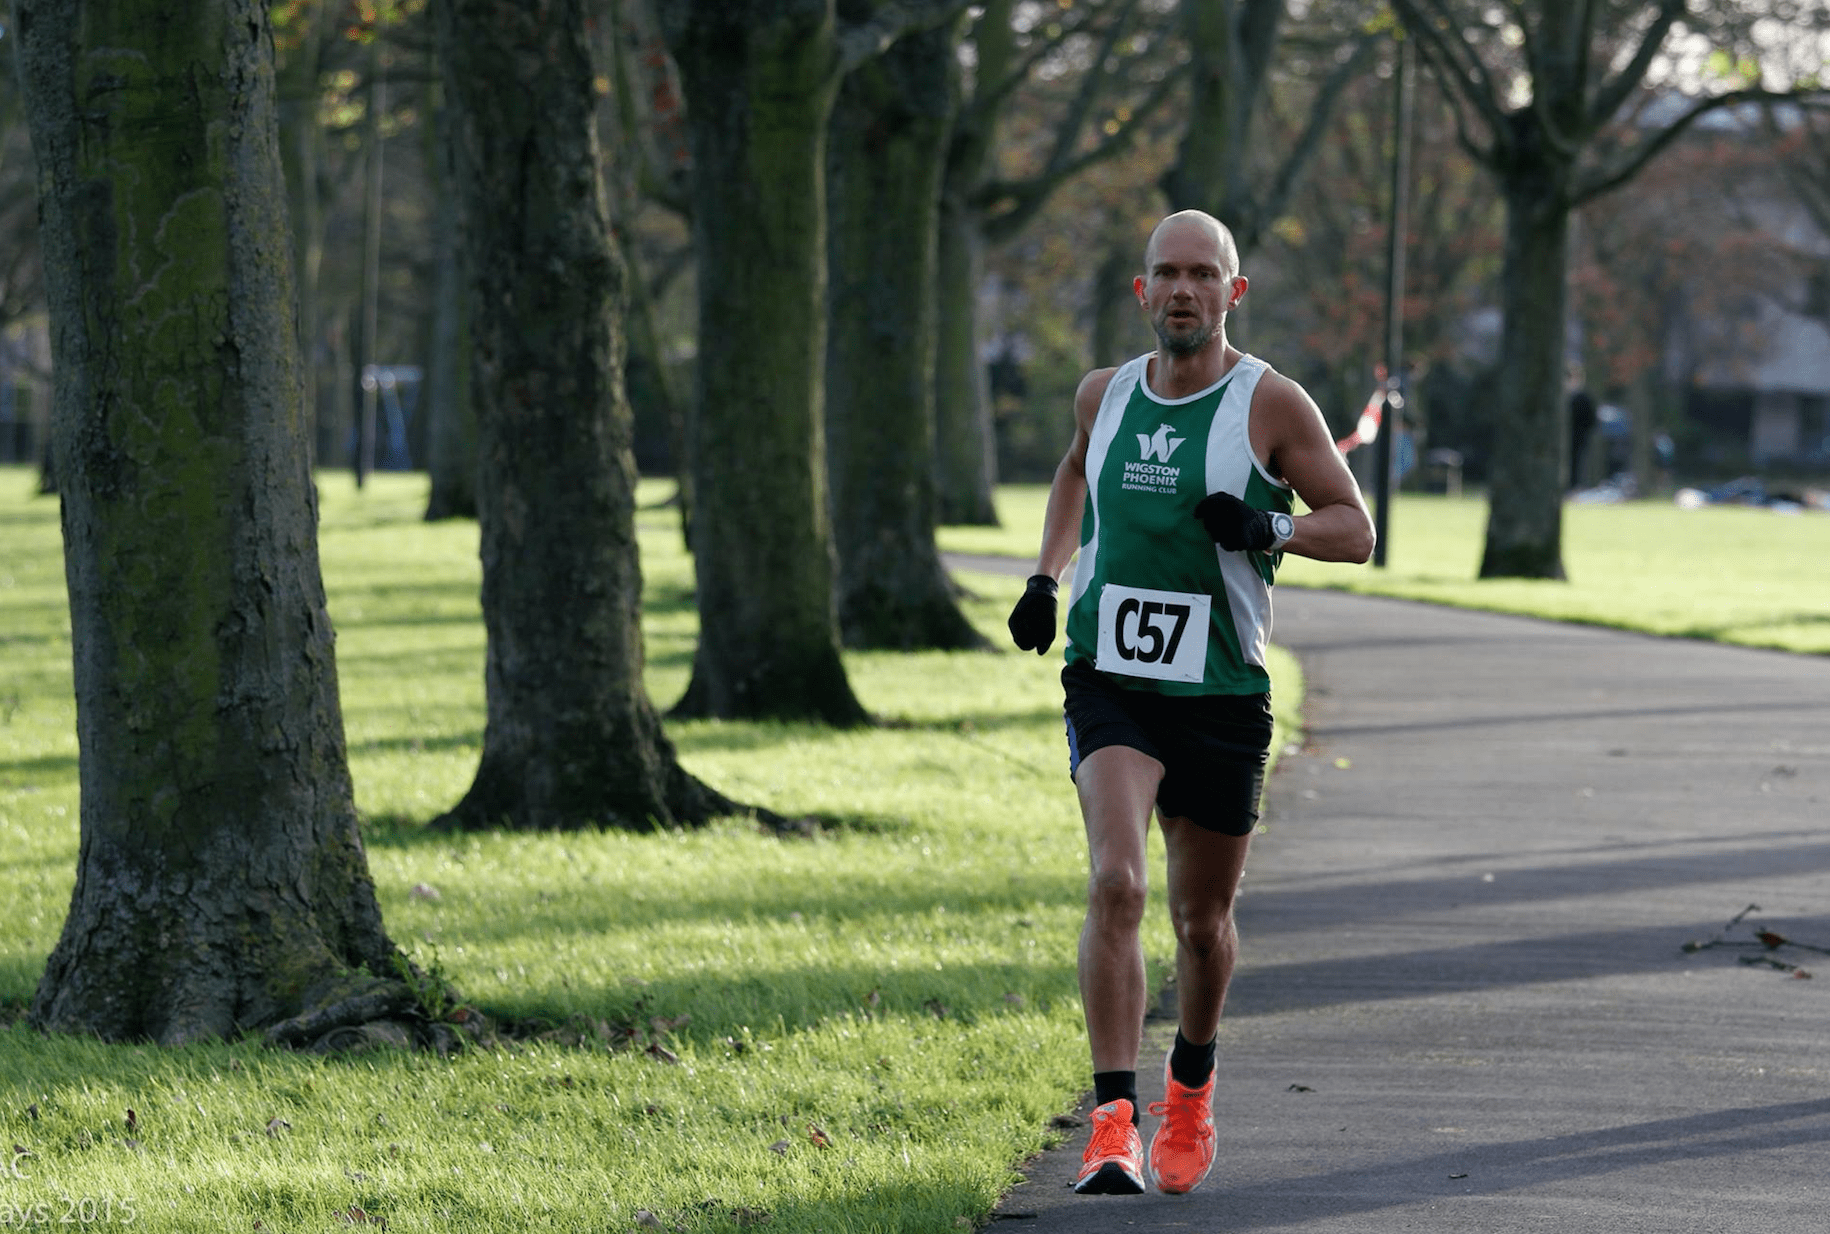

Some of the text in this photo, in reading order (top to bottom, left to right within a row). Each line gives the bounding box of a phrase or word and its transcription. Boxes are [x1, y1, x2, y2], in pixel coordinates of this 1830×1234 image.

[1125, 461, 1180, 476] WIGSTON
[1123, 472, 1177, 486] PHOENIX
[1122, 483, 1157, 492] RUNNING
[1115, 598, 1190, 664] C57
